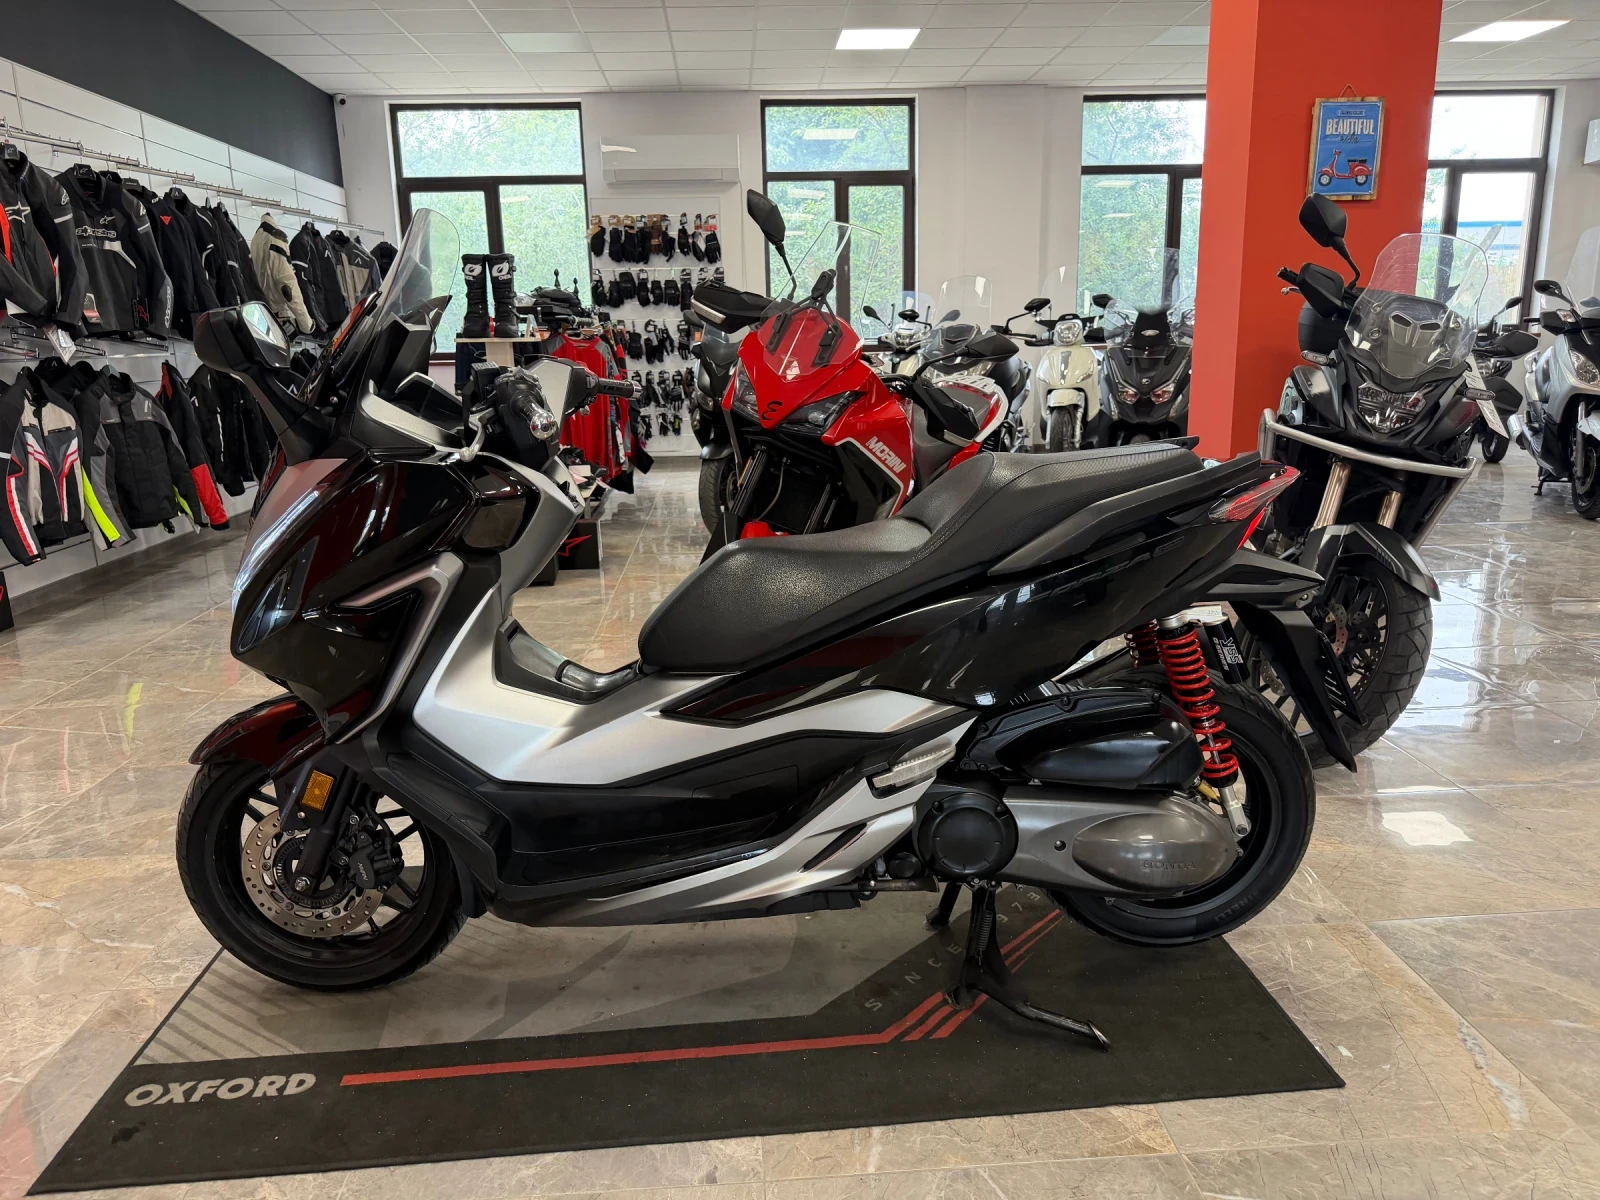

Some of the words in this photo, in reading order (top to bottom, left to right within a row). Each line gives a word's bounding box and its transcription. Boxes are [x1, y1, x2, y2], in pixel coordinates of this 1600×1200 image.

[1326, 118, 1375, 135] BEAUTIFUL
[865, 436, 907, 473] MORINI
[1220, 636, 1241, 664] YSS
[1142, 861, 1197, 871] HONDA
[864, 943, 962, 1011] SINCE
[996, 891, 1041, 923] 973
[124, 1072, 317, 1107] OXFORD
